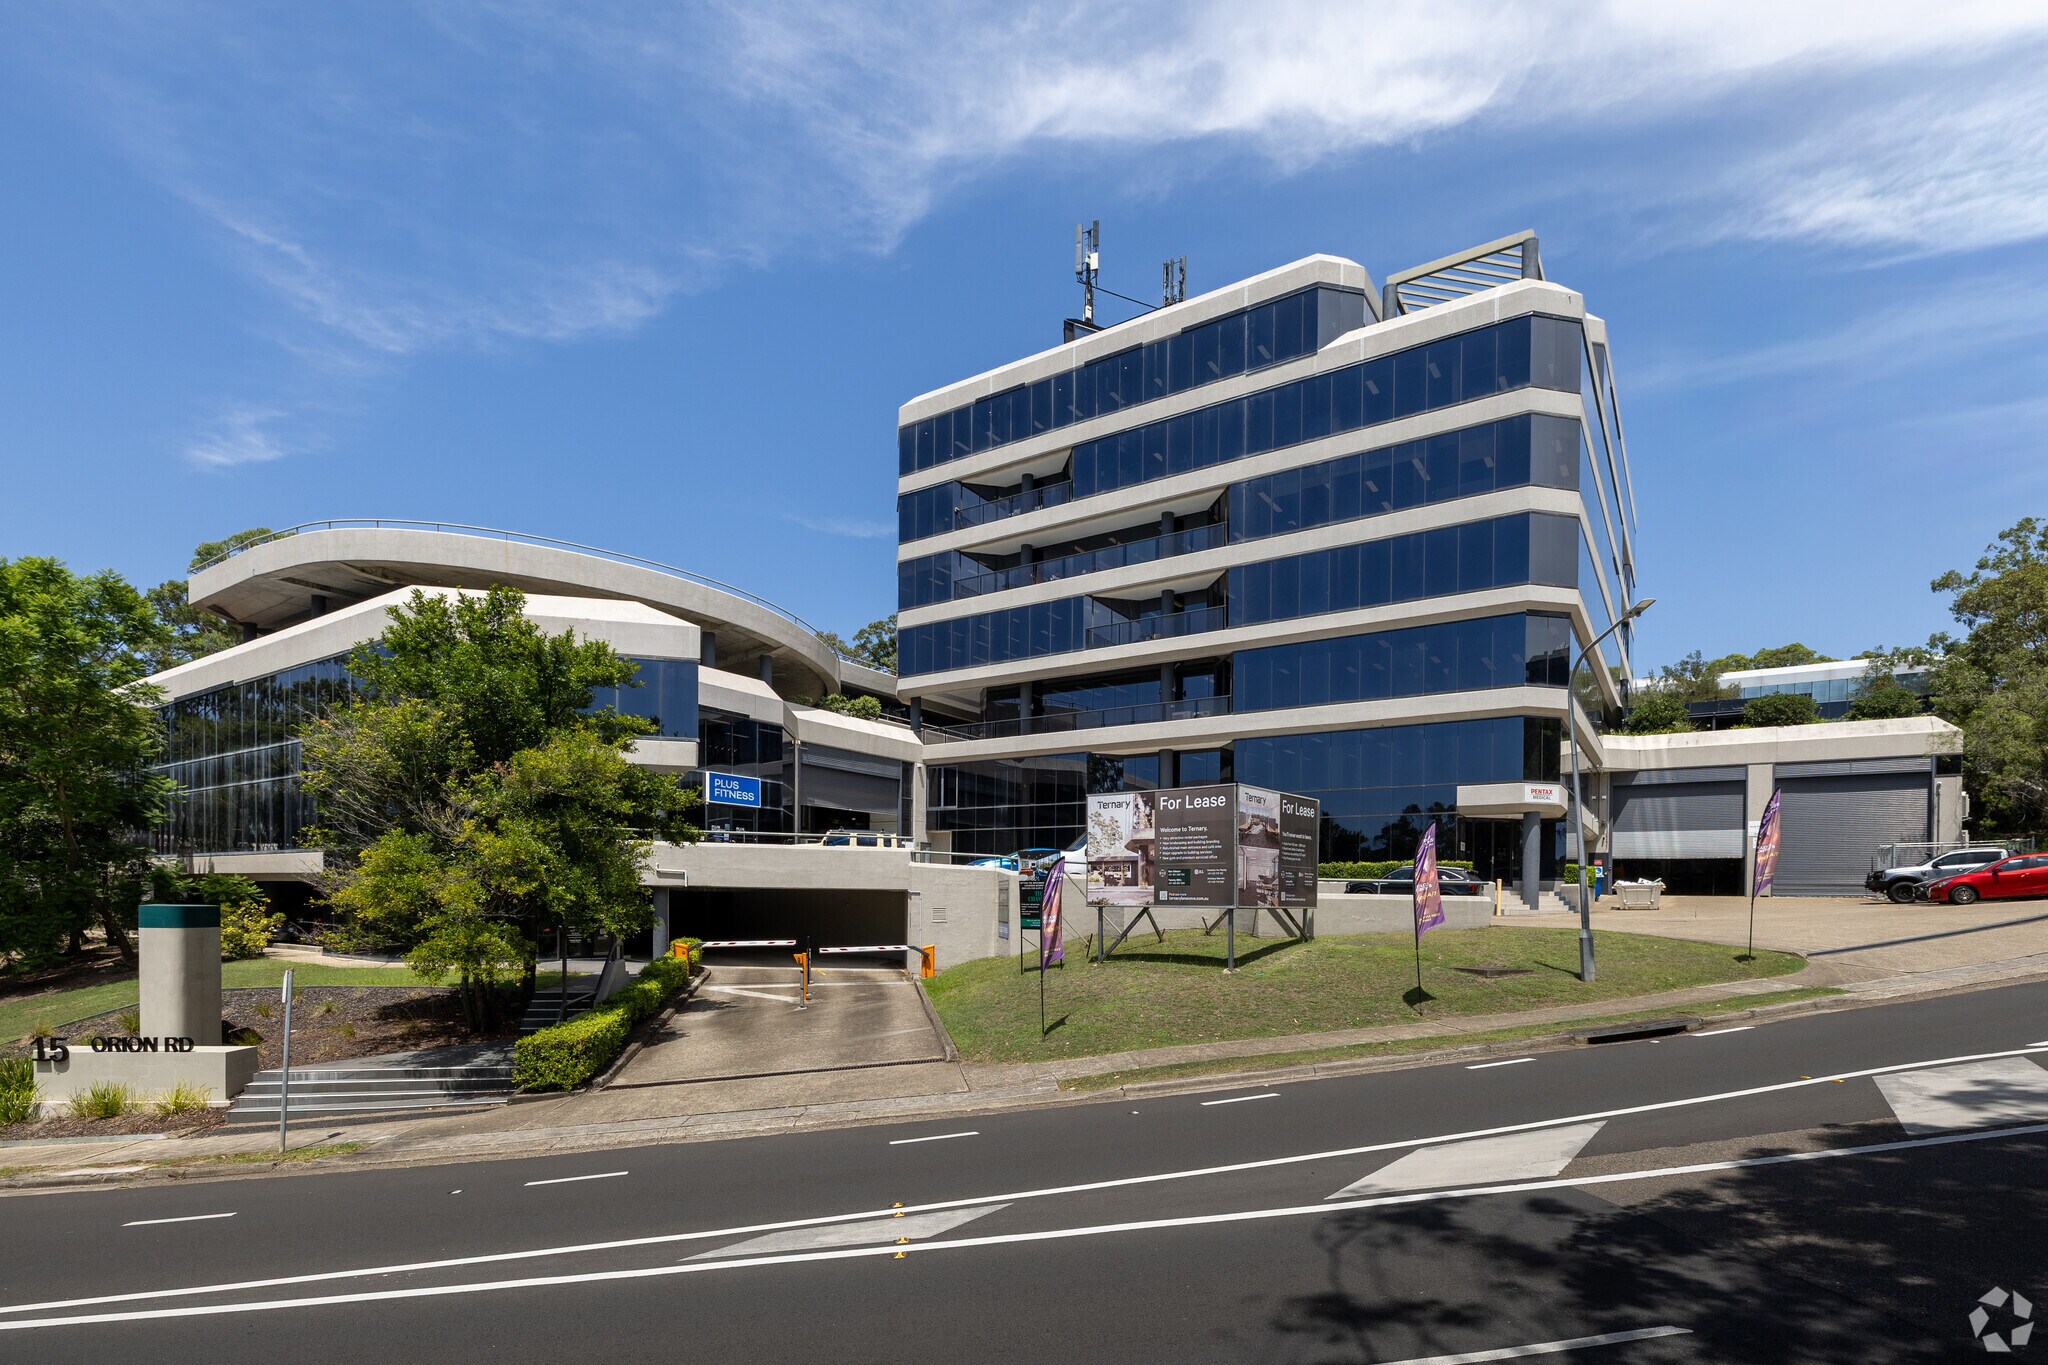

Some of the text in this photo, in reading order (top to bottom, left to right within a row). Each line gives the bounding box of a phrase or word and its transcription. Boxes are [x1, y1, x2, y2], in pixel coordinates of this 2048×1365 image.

[714, 778, 739, 790] PLUS
[714, 788, 755, 801] FITNESS
[1245, 792, 1267, 806] Ternary
[1097, 800, 1131, 810] Ternary
[1160, 795, 1226, 811] For Lease
[1282, 800, 1315, 818] For Lease
[31, 1036, 70, 1062] 15
[91, 1036, 195, 1053] ORION RD
